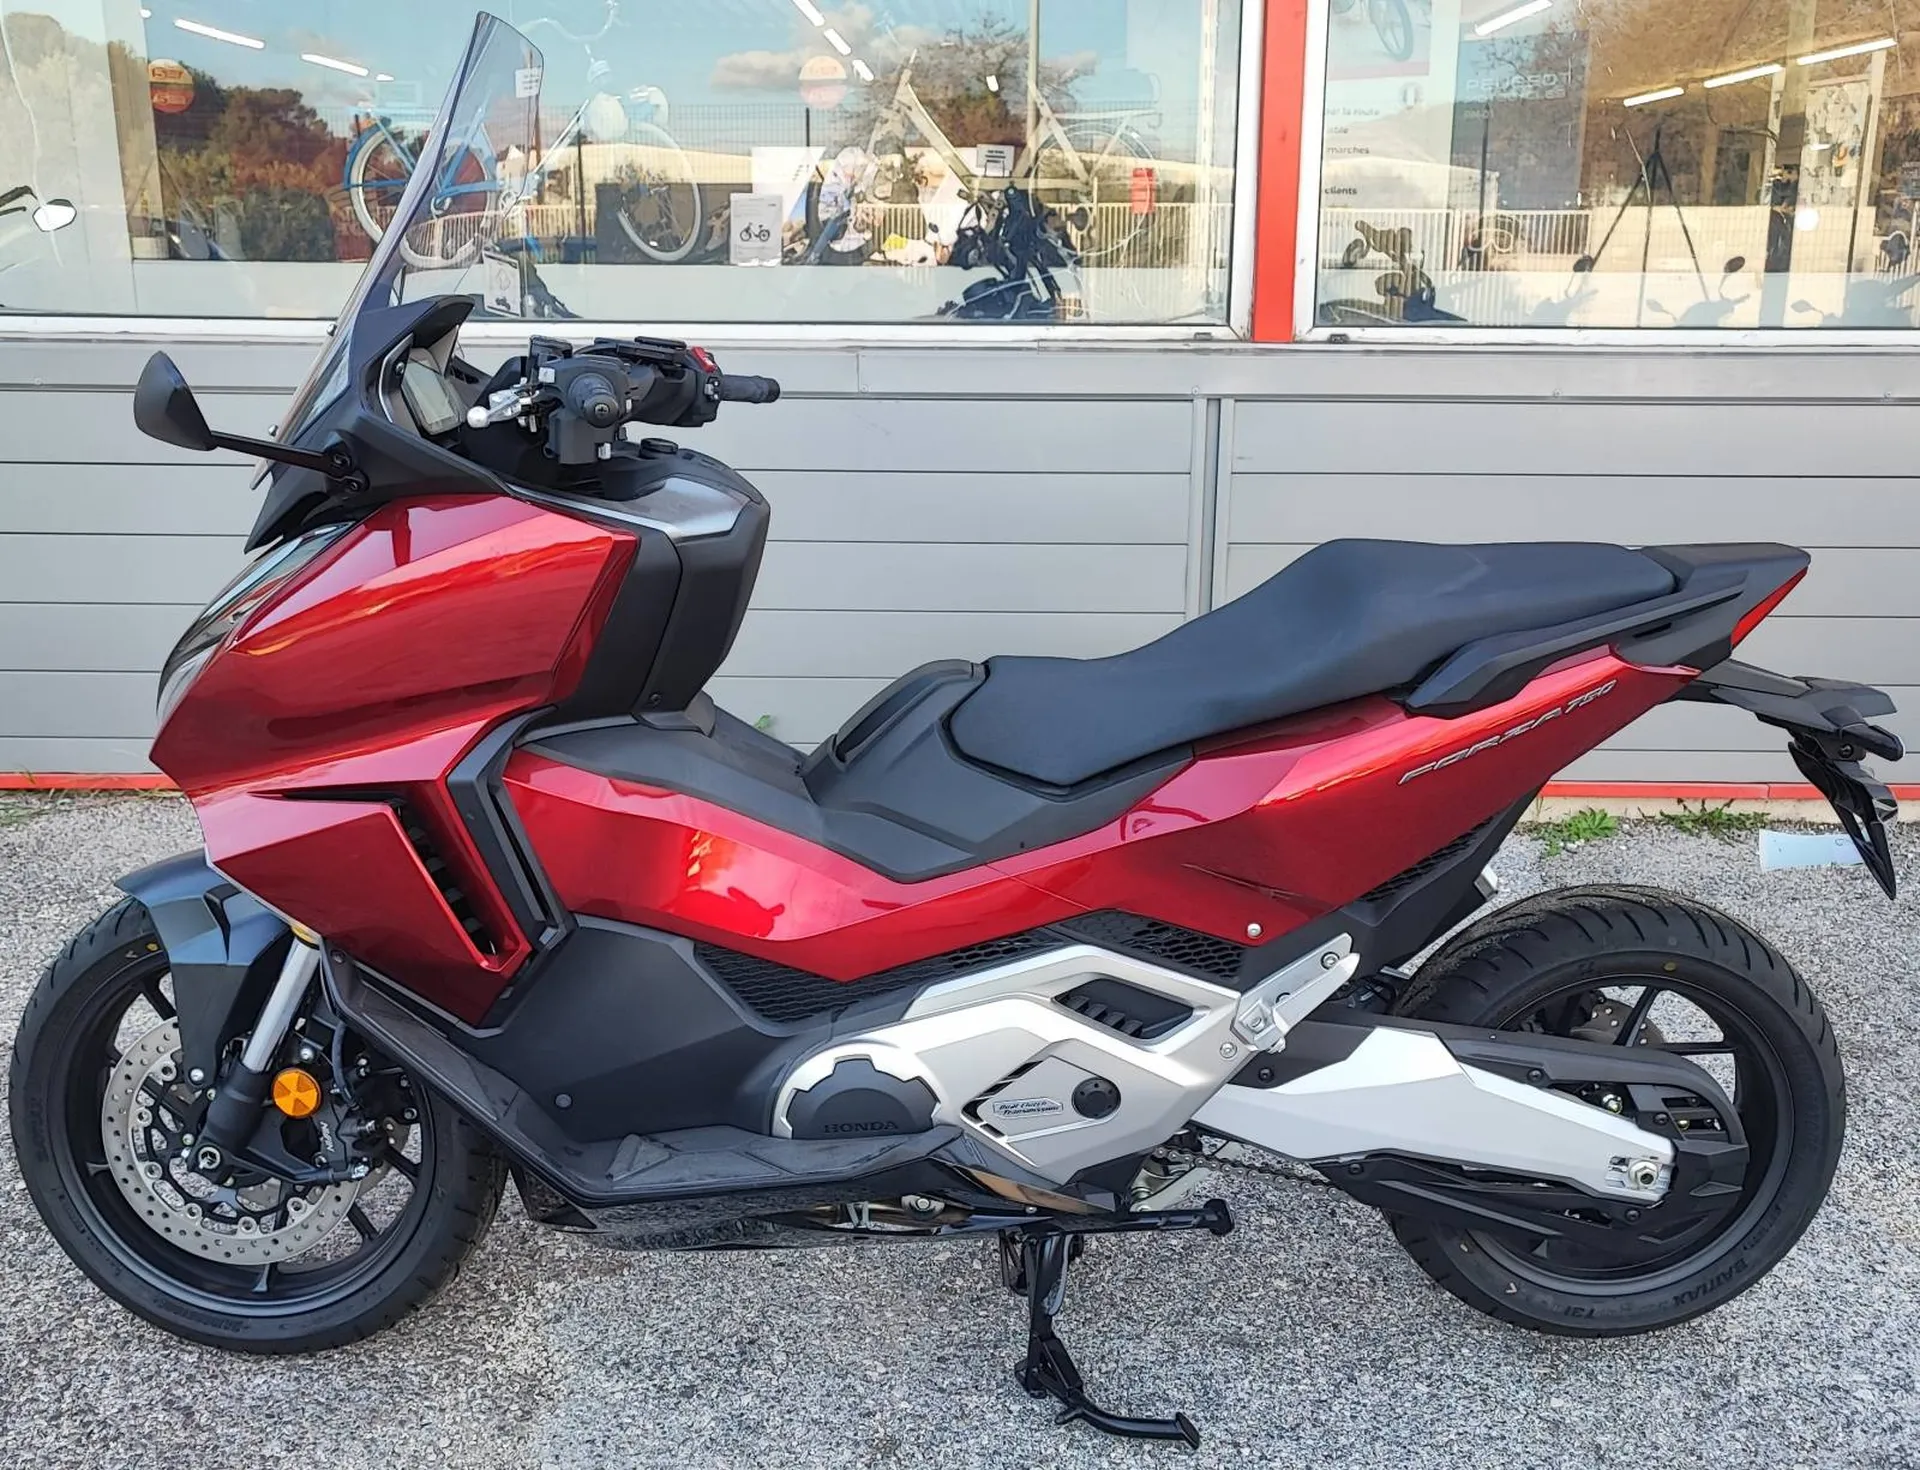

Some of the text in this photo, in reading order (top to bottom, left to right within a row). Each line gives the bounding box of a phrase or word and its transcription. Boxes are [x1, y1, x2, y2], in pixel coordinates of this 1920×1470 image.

[1323, 184, 1358, 196] clients
[1398, 679, 1617, 786] FORZA 750
[823, 1121, 900, 1134] HONDA
